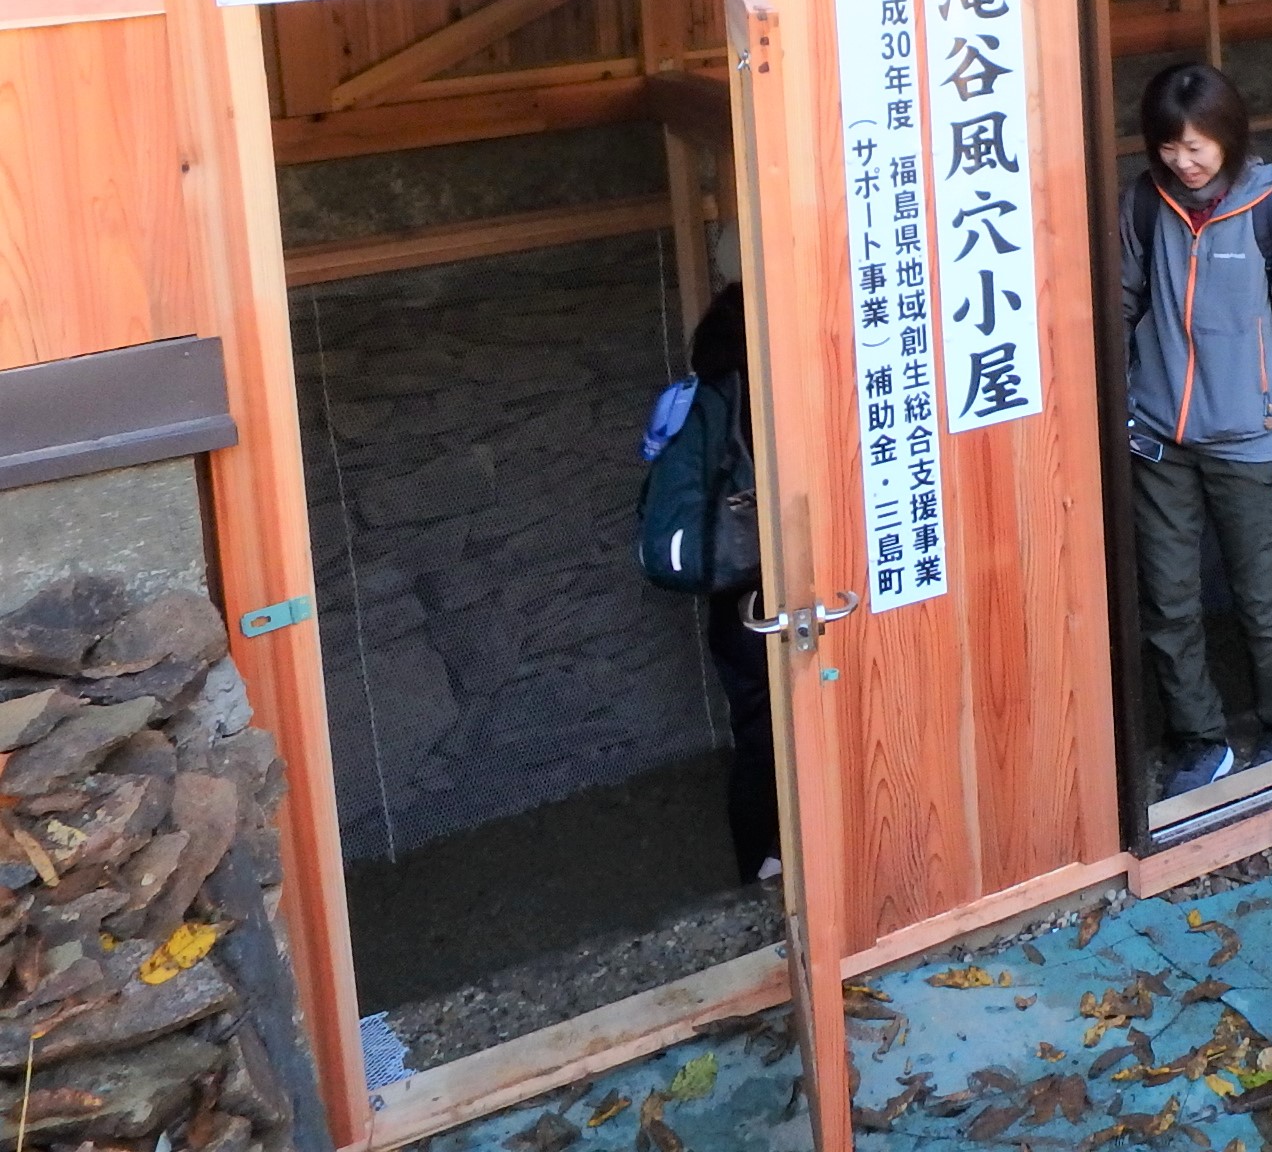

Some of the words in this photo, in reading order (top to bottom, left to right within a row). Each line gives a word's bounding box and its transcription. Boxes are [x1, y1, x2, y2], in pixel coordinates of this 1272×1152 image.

[890, 154, 942, 588] 福島県地域創生総合支援事業
